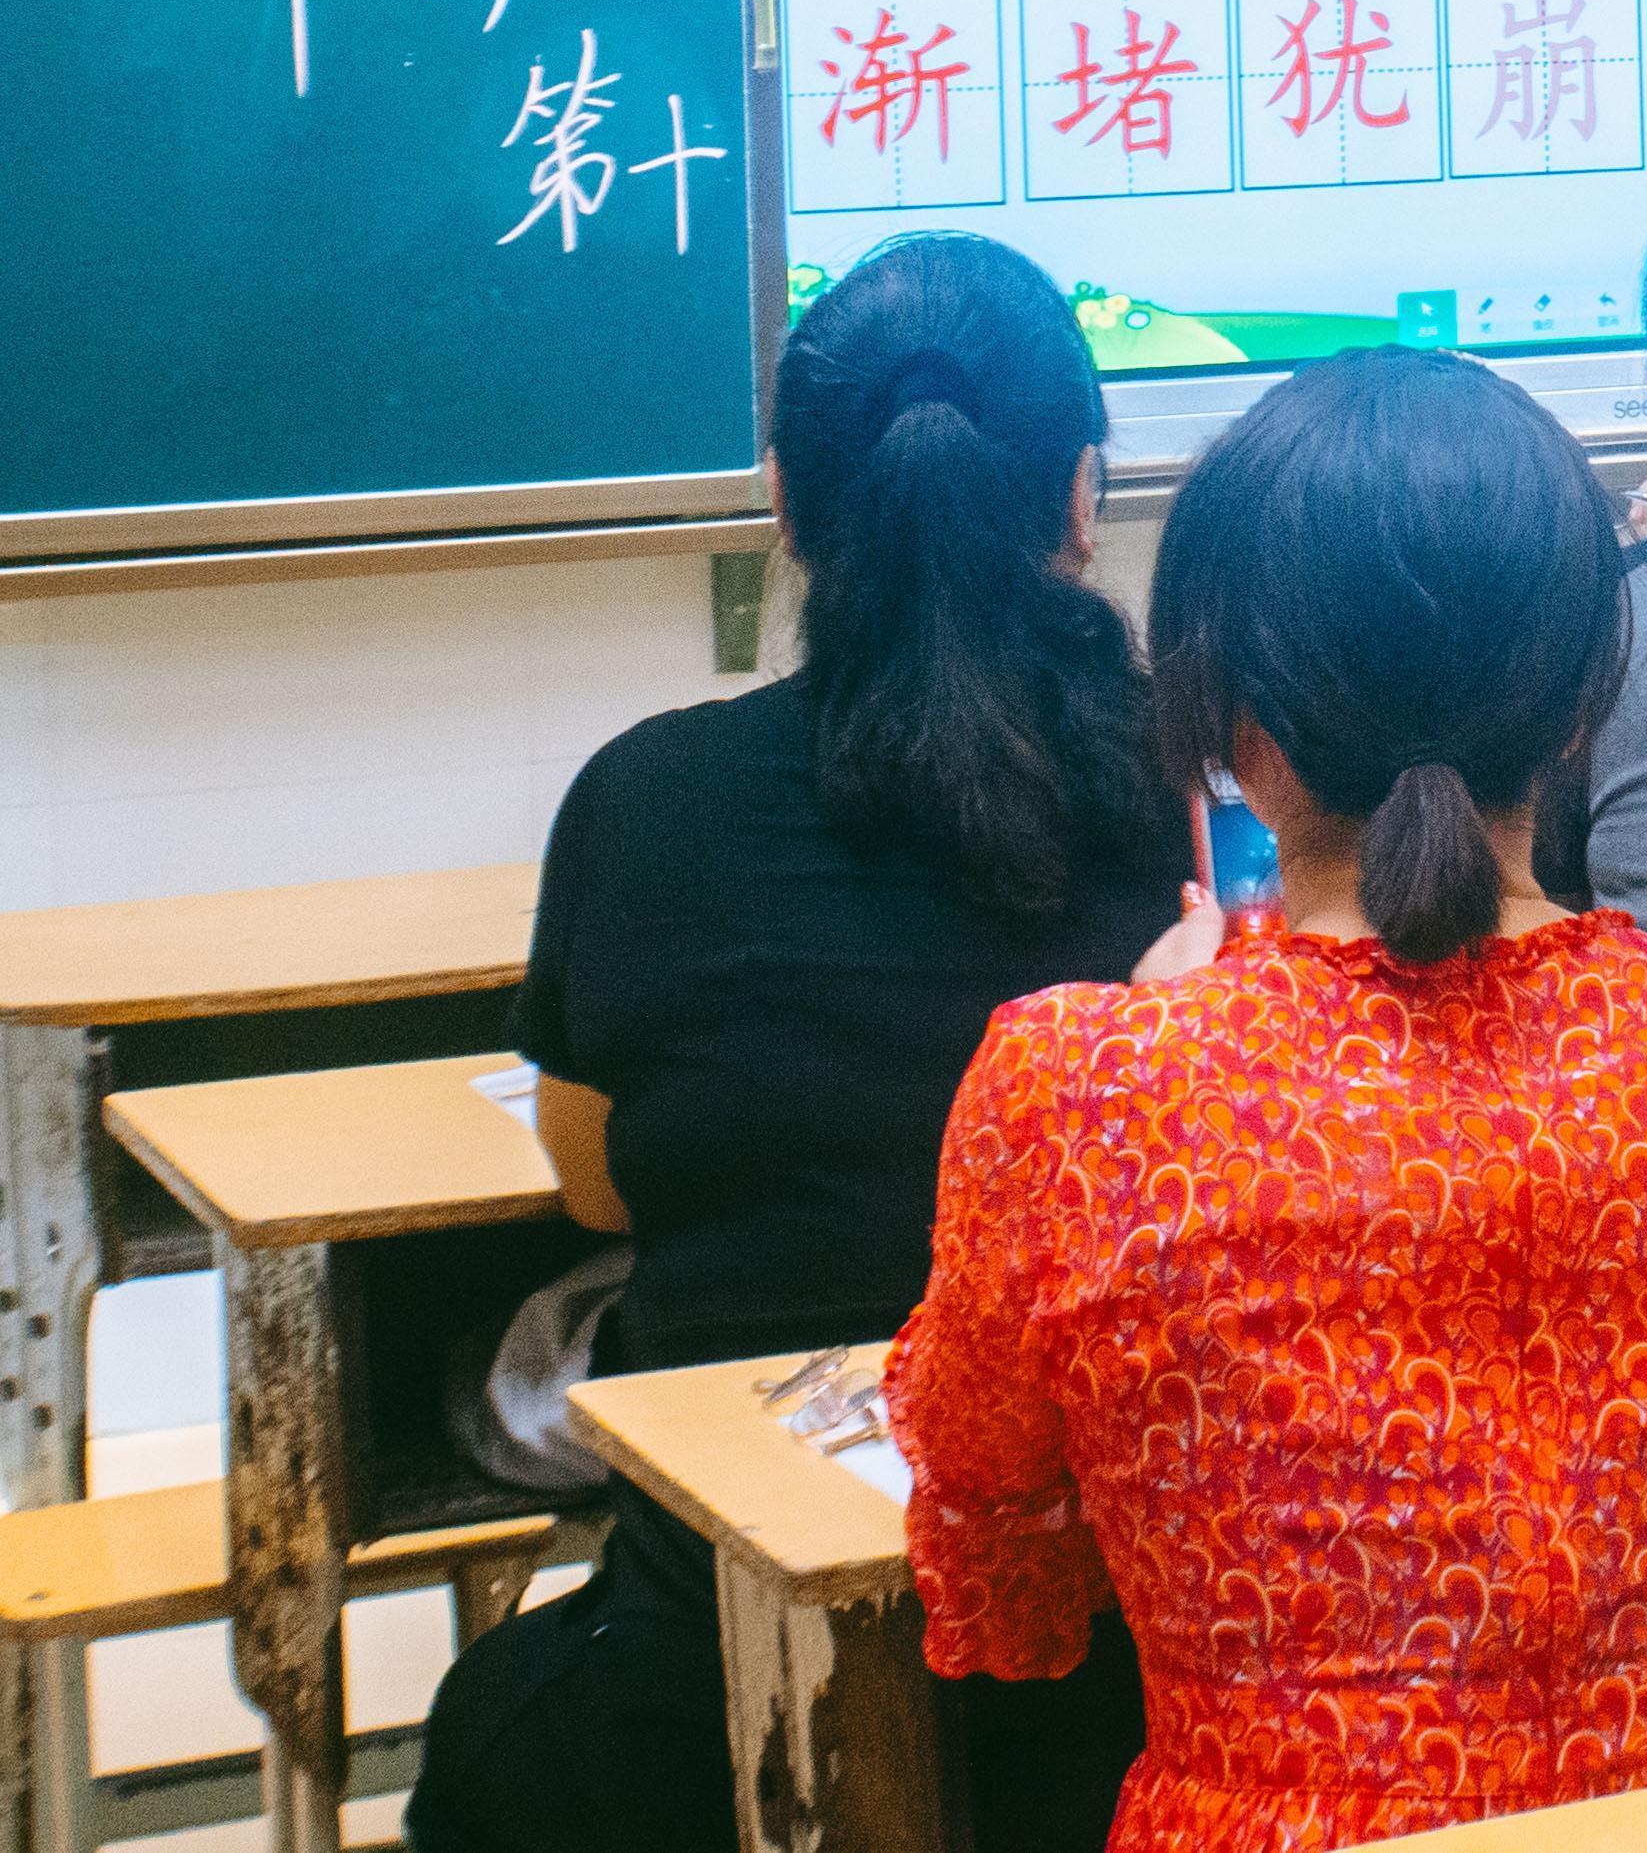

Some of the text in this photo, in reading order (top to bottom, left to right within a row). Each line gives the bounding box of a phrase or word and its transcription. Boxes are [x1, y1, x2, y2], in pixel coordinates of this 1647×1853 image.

[495, 27, 728, 255] 第十
[818, 8, 971, 164] 渐
[1052, 9, 1199, 161] 堵
